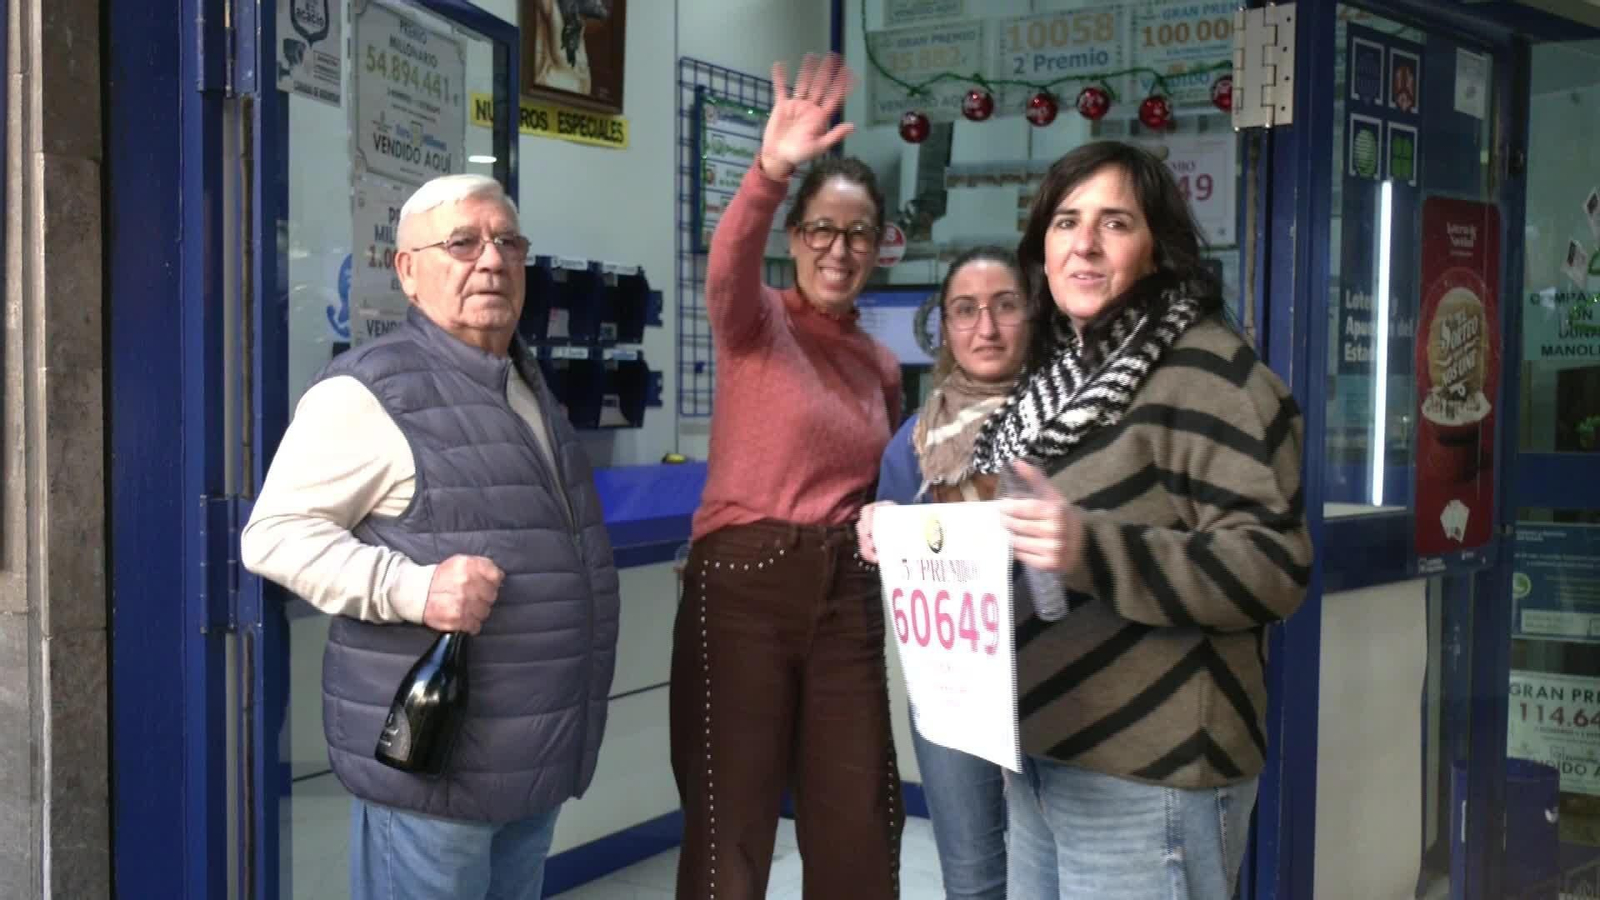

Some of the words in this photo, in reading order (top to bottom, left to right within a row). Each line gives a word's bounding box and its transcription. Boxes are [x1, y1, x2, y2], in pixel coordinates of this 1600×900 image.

[1006, 14, 1114, 52] 10058
[1143, 23, 1189, 47] 100
[1033, 46, 1110, 73] Premio
[558, 111, 622, 142] ESPECIALES
[373, 132, 421, 164] VENDIDO
[891, 588, 999, 656] 60649
[1509, 683, 1564, 700] GRAN
